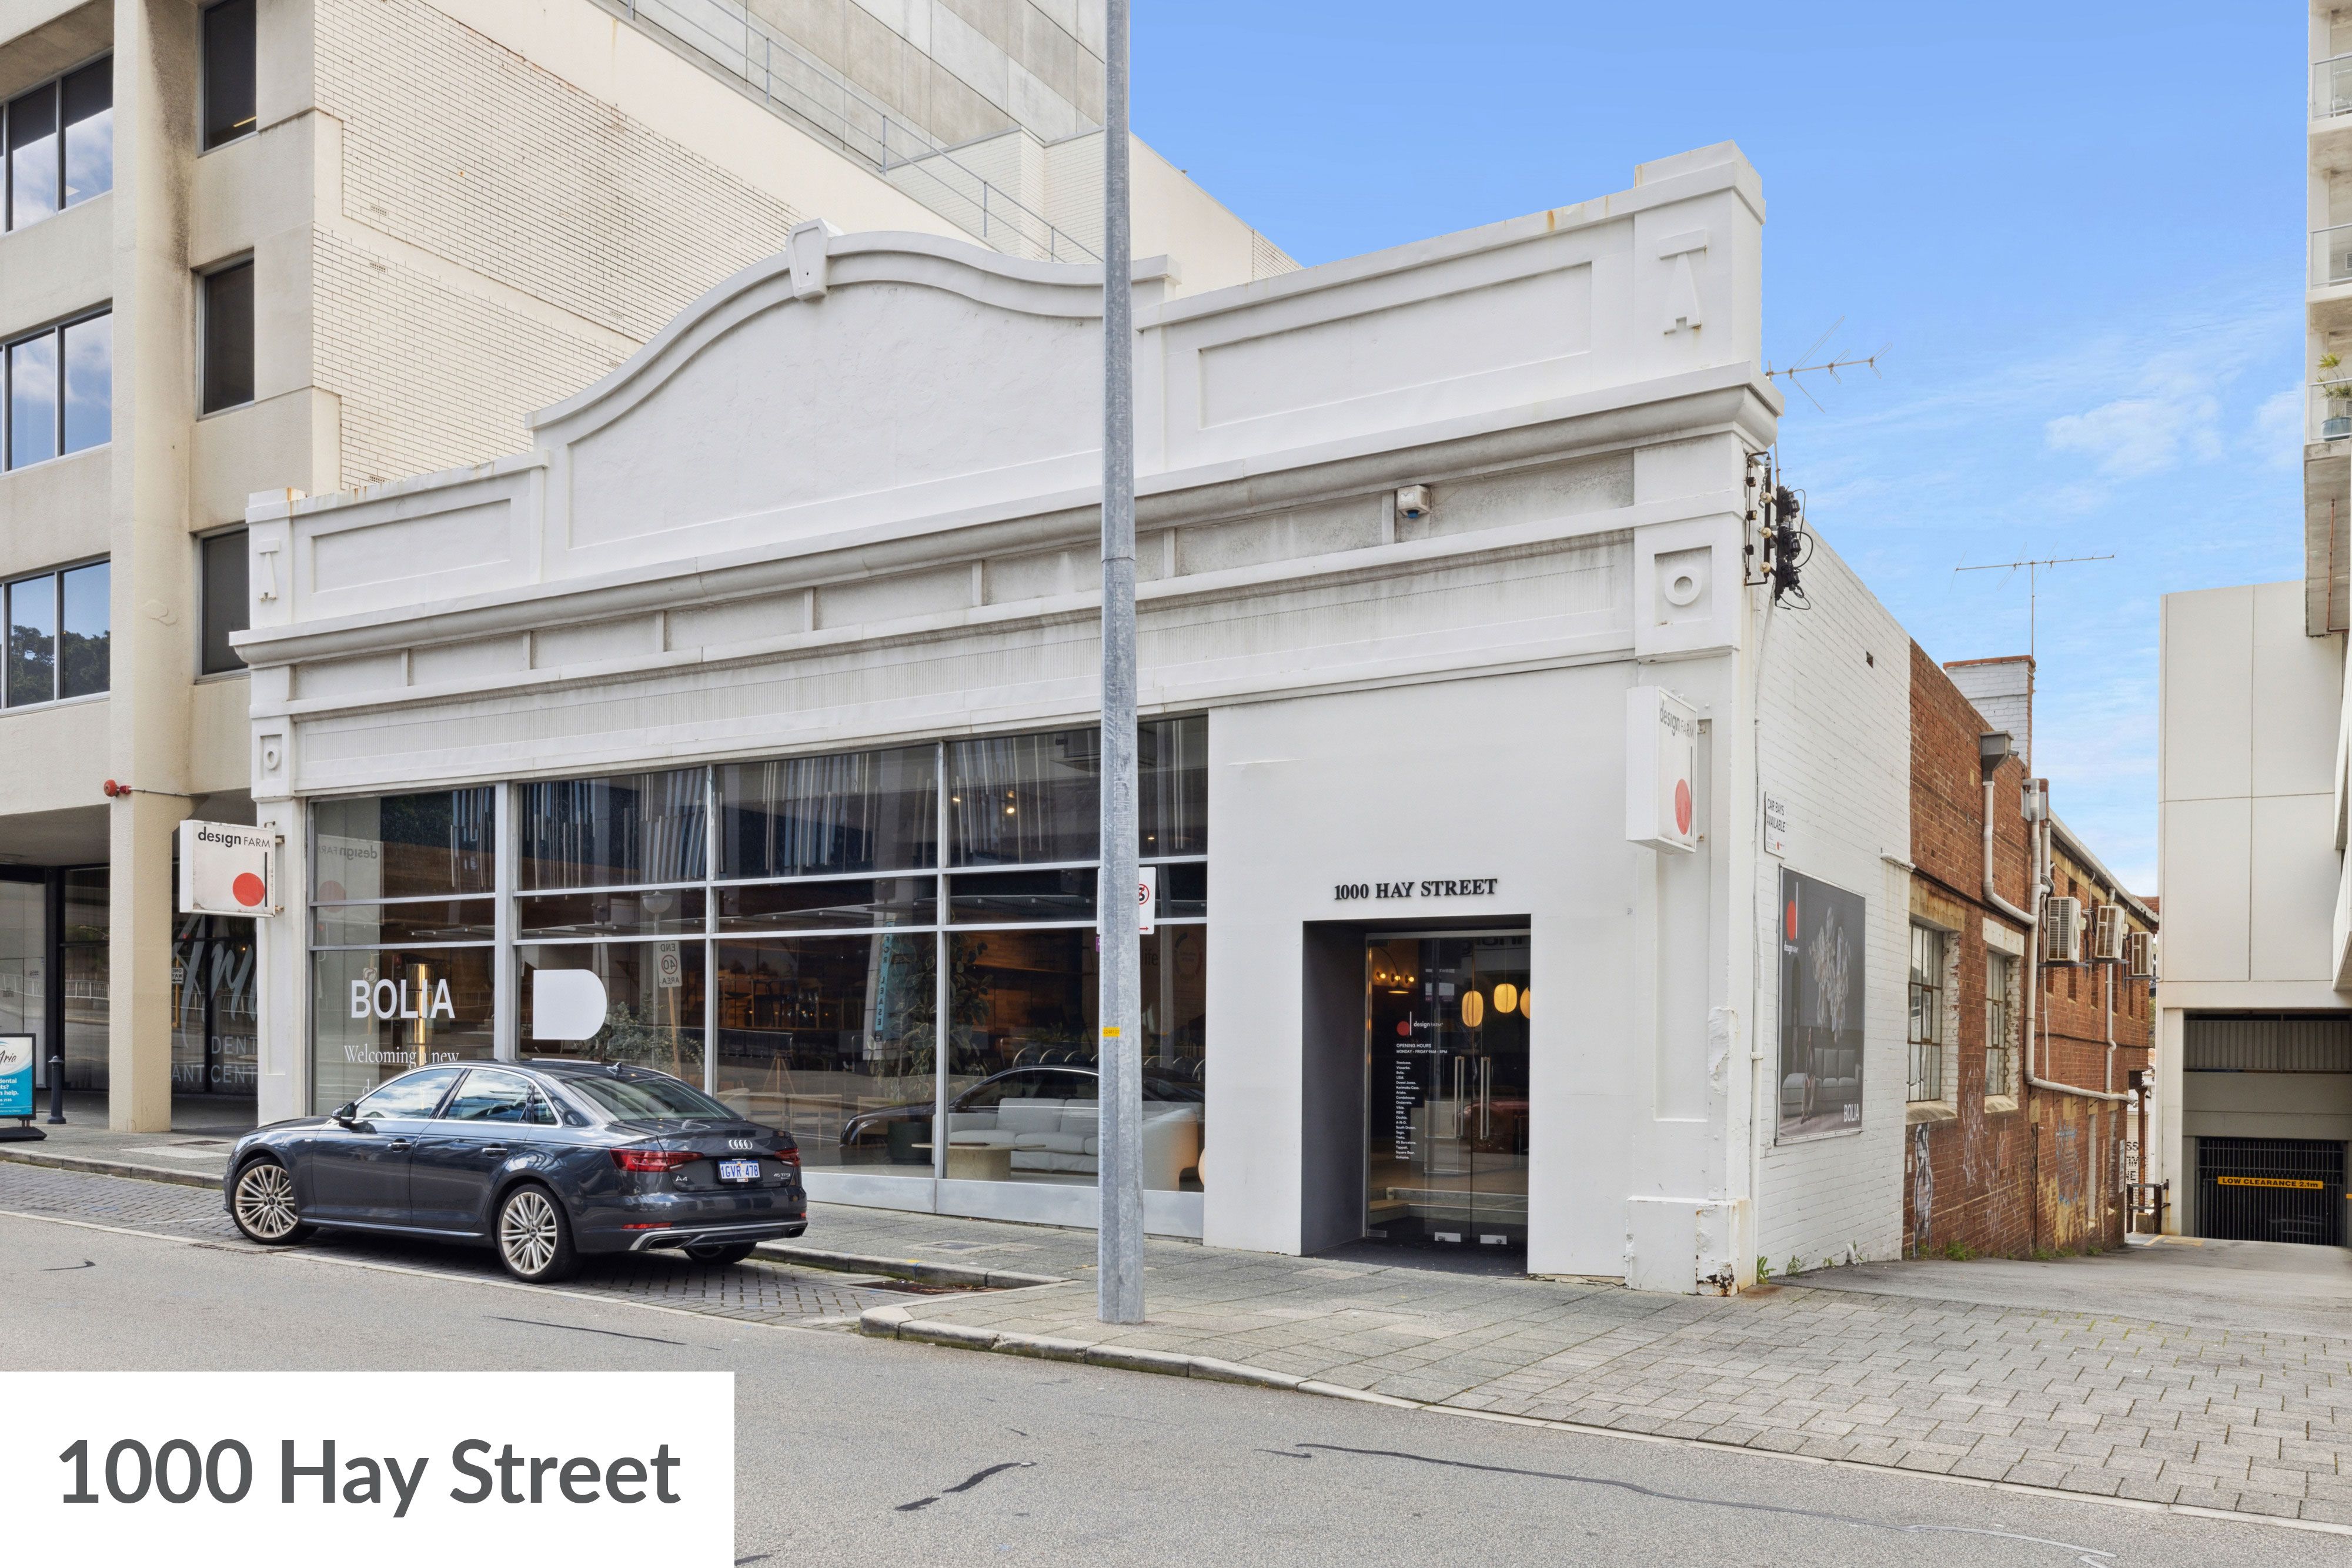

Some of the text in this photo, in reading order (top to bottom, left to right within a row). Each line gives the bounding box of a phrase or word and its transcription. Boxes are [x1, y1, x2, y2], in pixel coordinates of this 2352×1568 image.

[1767, 798, 1775, 811] CAR
[1766, 814, 1786, 833] AVAILABLE
[1334, 878, 1498, 900] 1000 HAY STREET
[351, 978, 456, 1019] BOLIA
[344, 1043, 417, 1070] Welcoming
[431, 1051, 460, 1063] new
[1843, 1104, 1859, 1122] BOLIA
[2243, 1179, 2297, 1187] CLEARANCE
